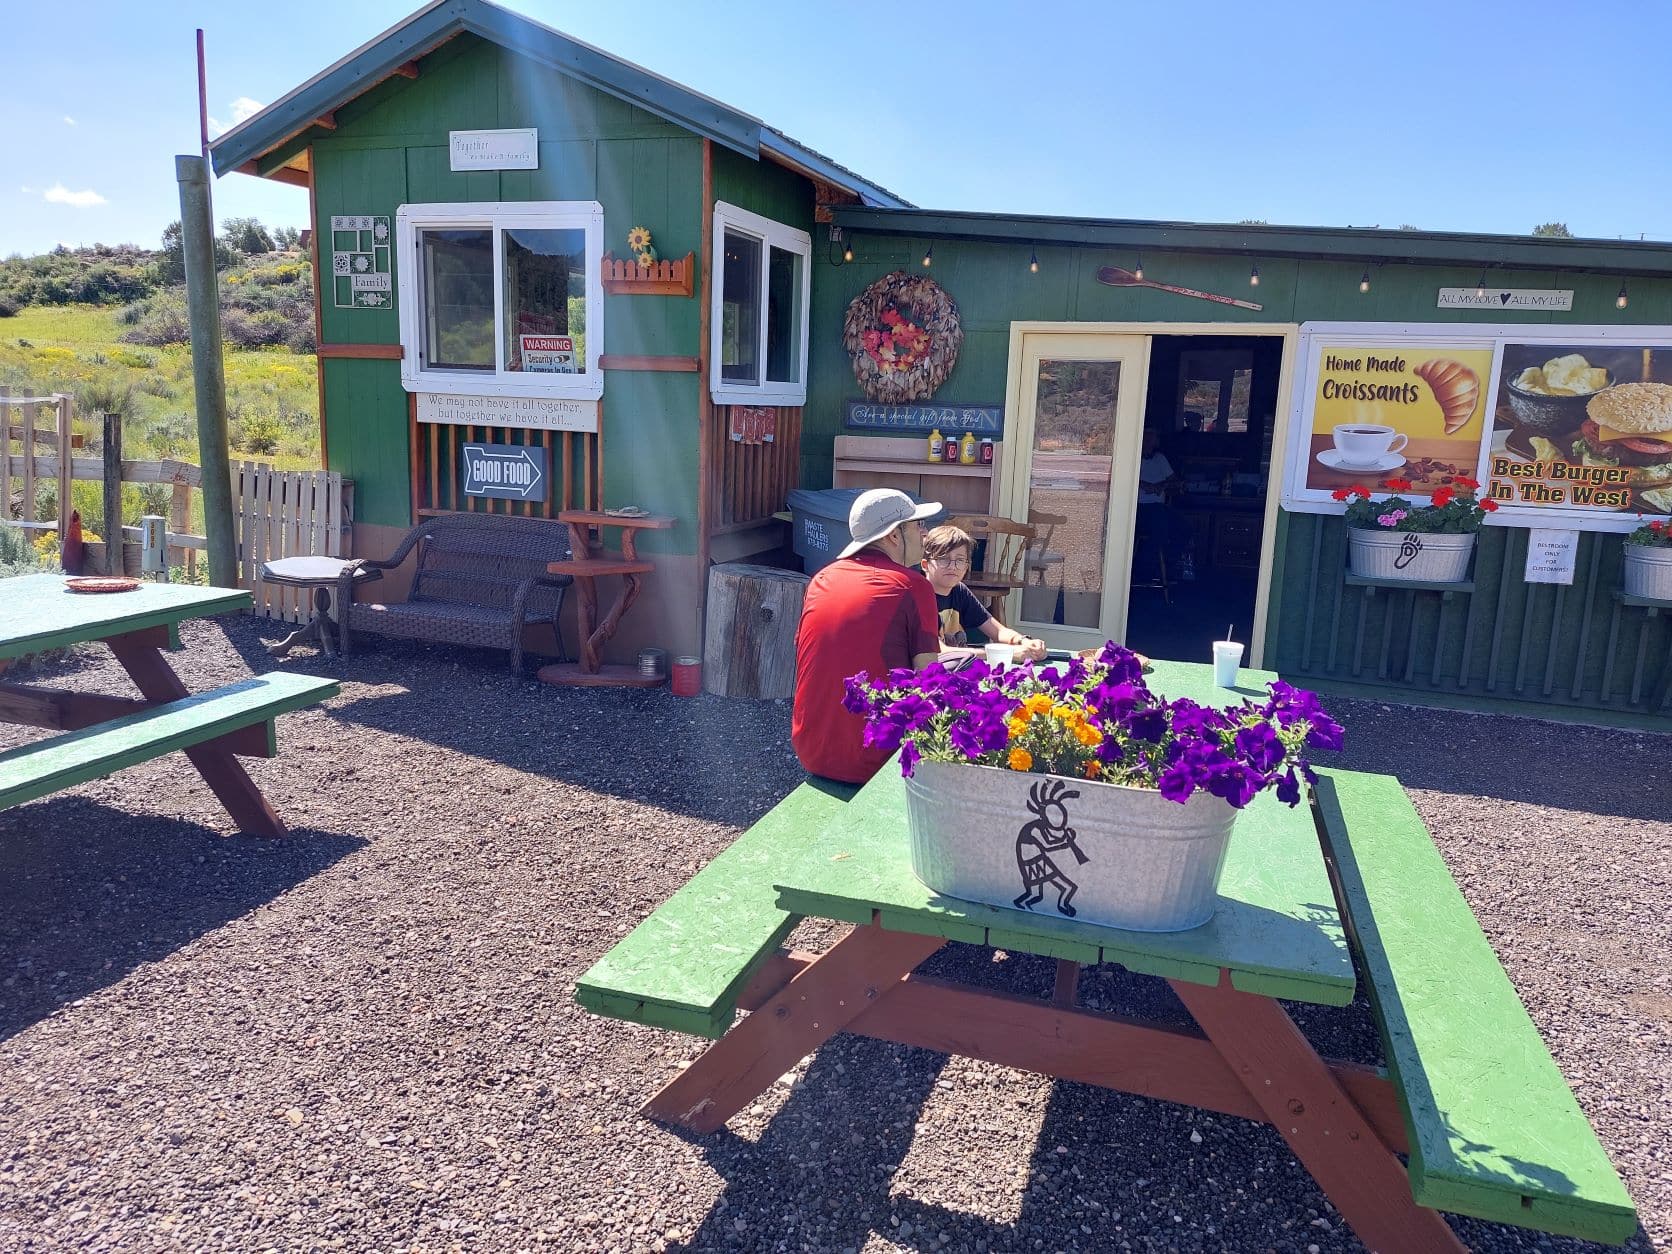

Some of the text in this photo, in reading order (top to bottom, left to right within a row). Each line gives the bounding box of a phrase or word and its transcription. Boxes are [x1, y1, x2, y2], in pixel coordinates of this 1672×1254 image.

[355, 276, 388, 290] Family
[1440, 294, 1568, 306] ALL MY LOVE ALL MY LIFE
[526, 340, 571, 350] WARNING
[528, 354, 553, 365] Security
[1325, 355, 1406, 373] Home Made
[1322, 379, 1420, 405] Croissants
[429, 394, 582, 414] We may not have it all together,
[438, 408, 453, 418] but
[456, 410, 496, 422] together
[499, 413, 512, 422] we
[515, 413, 538, 424] have
[541, 415, 548, 424] it
[851, 404, 1001, 430] CHILDREN
[889, 410, 916, 422] special
[959, 409, 984, 425] God
[473, 459, 531, 485] GOOD FOOD
[1493, 459, 1630, 486] Best Burger
[1490, 481, 1631, 507] In The West
